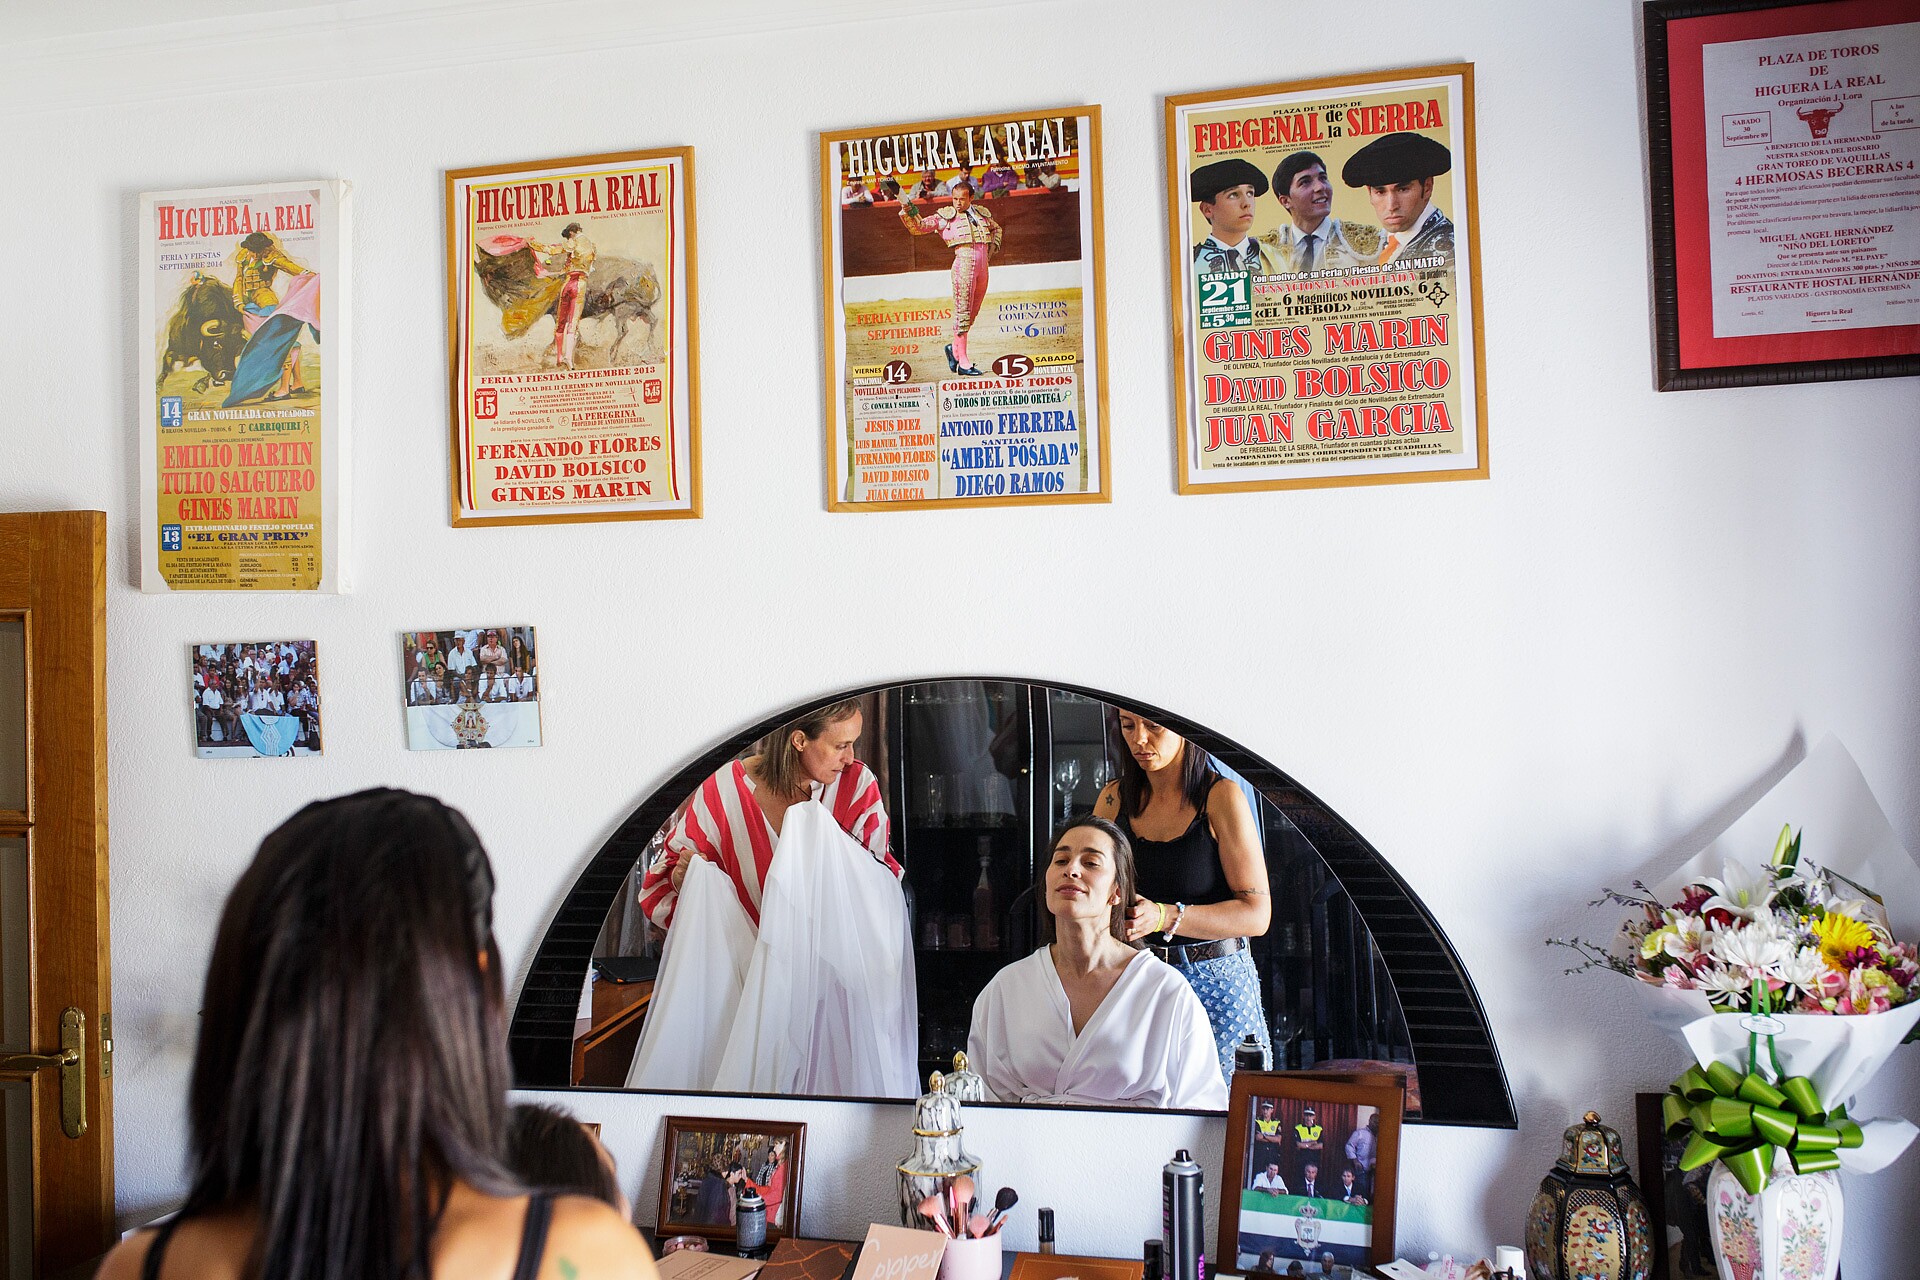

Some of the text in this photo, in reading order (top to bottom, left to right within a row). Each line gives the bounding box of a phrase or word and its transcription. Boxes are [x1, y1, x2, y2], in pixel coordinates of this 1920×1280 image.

[1759, 44, 1880, 66] PLAZA DE TOROS
[1809, 65, 1828, 76] DE
[1755, 74, 1885, 97] HIGUERA LA REAL
[1778, 95, 1831, 107] Organización
[1842, 92, 1862, 100] Lora
[1194, 99, 1443, 153] FREGENAL de SIERRA
[1328, 125, 1342, 138] la
[847, 118, 1072, 178] HIGUERA LA REAL
[1757, 152, 1890, 171] GRAN TOREO DE VAQUILLAS
[1735, 160, 1914, 186] 4 HERMOSAS BECERRAS 4
[477, 173, 661, 223] HIGUERA LA REAL
[158, 204, 314, 240] HIGUERA LA REAL
[1760, 225, 1894, 243] MIGUEL ANGEL HERNÁNDEZ
[1810, 240, 1828, 249] DEL
[161, 253, 182, 261] FERIA
[191, 252, 221, 260] FIESTAS
[159, 262, 205, 270] SEPTIEMBRE
[1253, 275, 1267, 283] Con
[1270, 272, 1296, 282] motivo
[1298, 271, 1308, 280] de
[1321, 268, 1342, 278] Feria
[1352, 265, 1380, 275] Fiestas
[1382, 264, 1393, 272] de
[1395, 259, 1412, 271] SAN
[1414, 256, 1444, 269] MATEO
[1201, 272, 1247, 282] SABADO
[1730, 271, 1920, 294] RESTAURANTE HOSTAL HERNÁNDE
[1202, 280, 1247, 306] 21
[1283, 294, 1291, 306] 6
[1351, 285, 1414, 300] NOVILLOS,
[1419, 282, 1427, 294] 6
[857, 309, 951, 324] FERIA Y FIESTAS
[868, 326, 942, 340] SEPTIEMBRE
[1203, 315, 1449, 363] GINES MARIN
[890, 345, 919, 354] 2012
[527, 373, 566, 382] FIESTAS
[568, 369, 632, 380] SEPTIEMBRE
[886, 363, 907, 382] 14
[1000, 358, 1027, 377] 15
[605, 379, 642, 387] NOVILLADAS
[942, 376, 1072, 392] CORRIDA DE TOROS
[1294, 358, 1450, 399] BOLSICO
[476, 397, 496, 416] 15
[954, 397, 979, 408] TOROS
[981, 397, 991, 406] DE
[993, 395, 1029, 406] GERARDO
[1031, 393, 1061, 404] ORTEGA
[162, 402, 180, 418] 14
[188, 409, 315, 421] GRAN NOVILLADA CON PICADORES
[585, 410, 636, 420] PEREGRINA
[249, 422, 300, 431] CARRIQUIRI
[865, 418, 920, 432] JESUS DIEZ
[941, 410, 1076, 437] ANTONIO FERRERA
[1206, 402, 1453, 451] JUAN GARCIA
[477, 436, 661, 460] FERNANDO FLORES
[856, 440, 869, 449] LUIS
[871, 439, 897, 448] MANUEL
[899, 434, 935, 446] TERRON
[164, 442, 313, 469] EMILIO MARTIN
[856, 451, 935, 465] FERNANDO FLORES
[495, 459, 646, 480] DAVID BOLSICO
[862, 469, 929, 483] DAVID BOLSICO
[162, 469, 315, 494] TULIO SALGUERO
[956, 472, 1064, 496] DIEGO RAMOS
[492, 481, 652, 502] GINES MARIN
[866, 488, 924, 501] JUAN GARCIA
[179, 497, 299, 521] GINES MARIN
[163, 531, 179, 542] 13
[218, 532, 258, 541] GRAN
